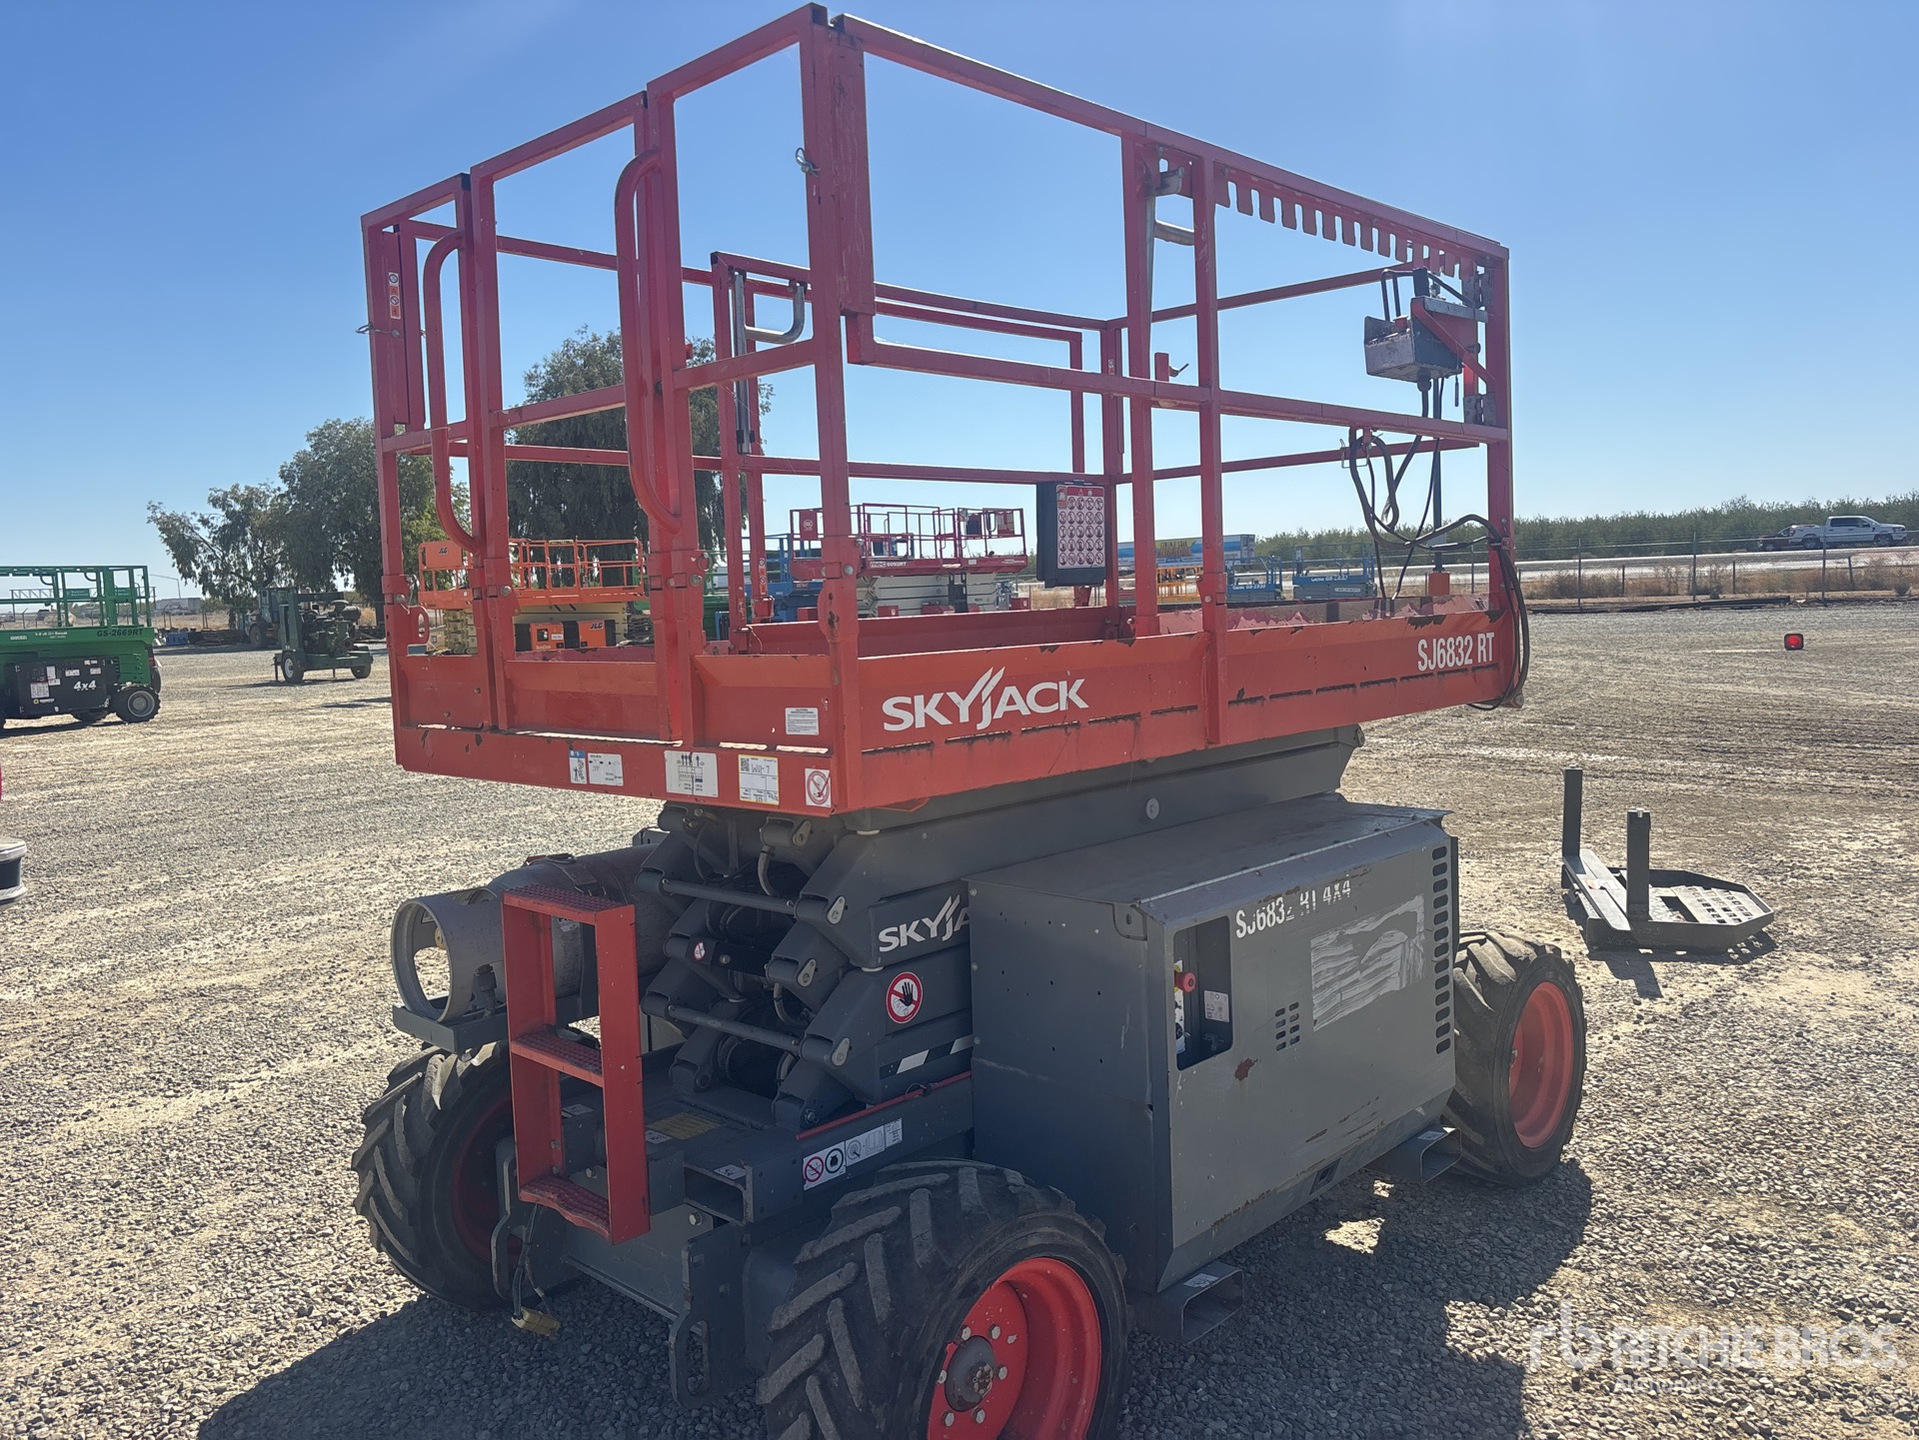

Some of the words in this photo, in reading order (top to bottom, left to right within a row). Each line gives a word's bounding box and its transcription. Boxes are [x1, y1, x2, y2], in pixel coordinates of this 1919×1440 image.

[590, 622, 604, 630] JLG
[96, 628, 144, 638] GS-2669RT
[1417, 635, 1473, 671] SJ6832
[1477, 632, 1495, 663] RT
[73, 680, 97, 691] 4x4
[881, 665, 1090, 732] SKYJACK
